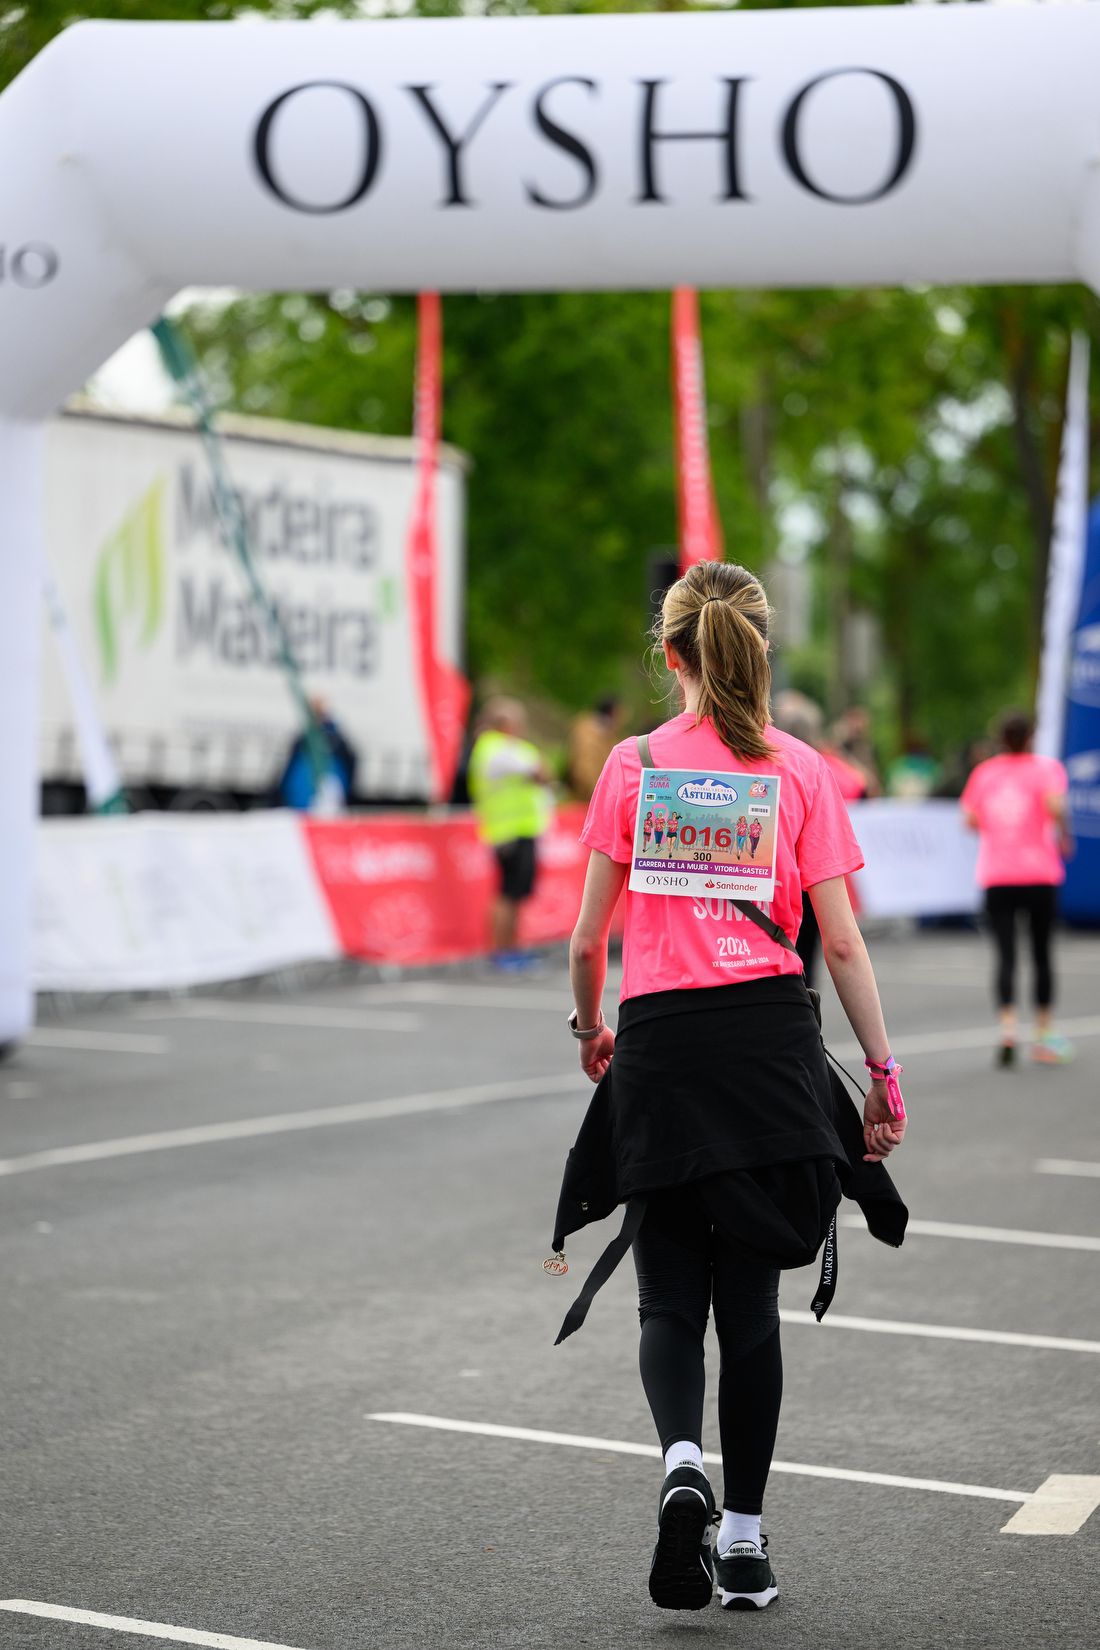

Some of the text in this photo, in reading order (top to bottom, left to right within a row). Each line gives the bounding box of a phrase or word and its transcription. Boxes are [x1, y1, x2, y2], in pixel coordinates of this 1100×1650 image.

[251, 67, 918, 213] OYSHO
[681, 787, 733, 802] ASTURIANA
[680, 825, 732, 848] 016
[693, 852, 712, 862] 300
[638, 860, 666, 869] CARRERA
[714, 865, 769, 876] VITORIA-GASTEIZ
[646, 875, 689, 887] OYSHO
[716, 881, 758, 892] Santander
[717, 936, 751, 957] 2024
